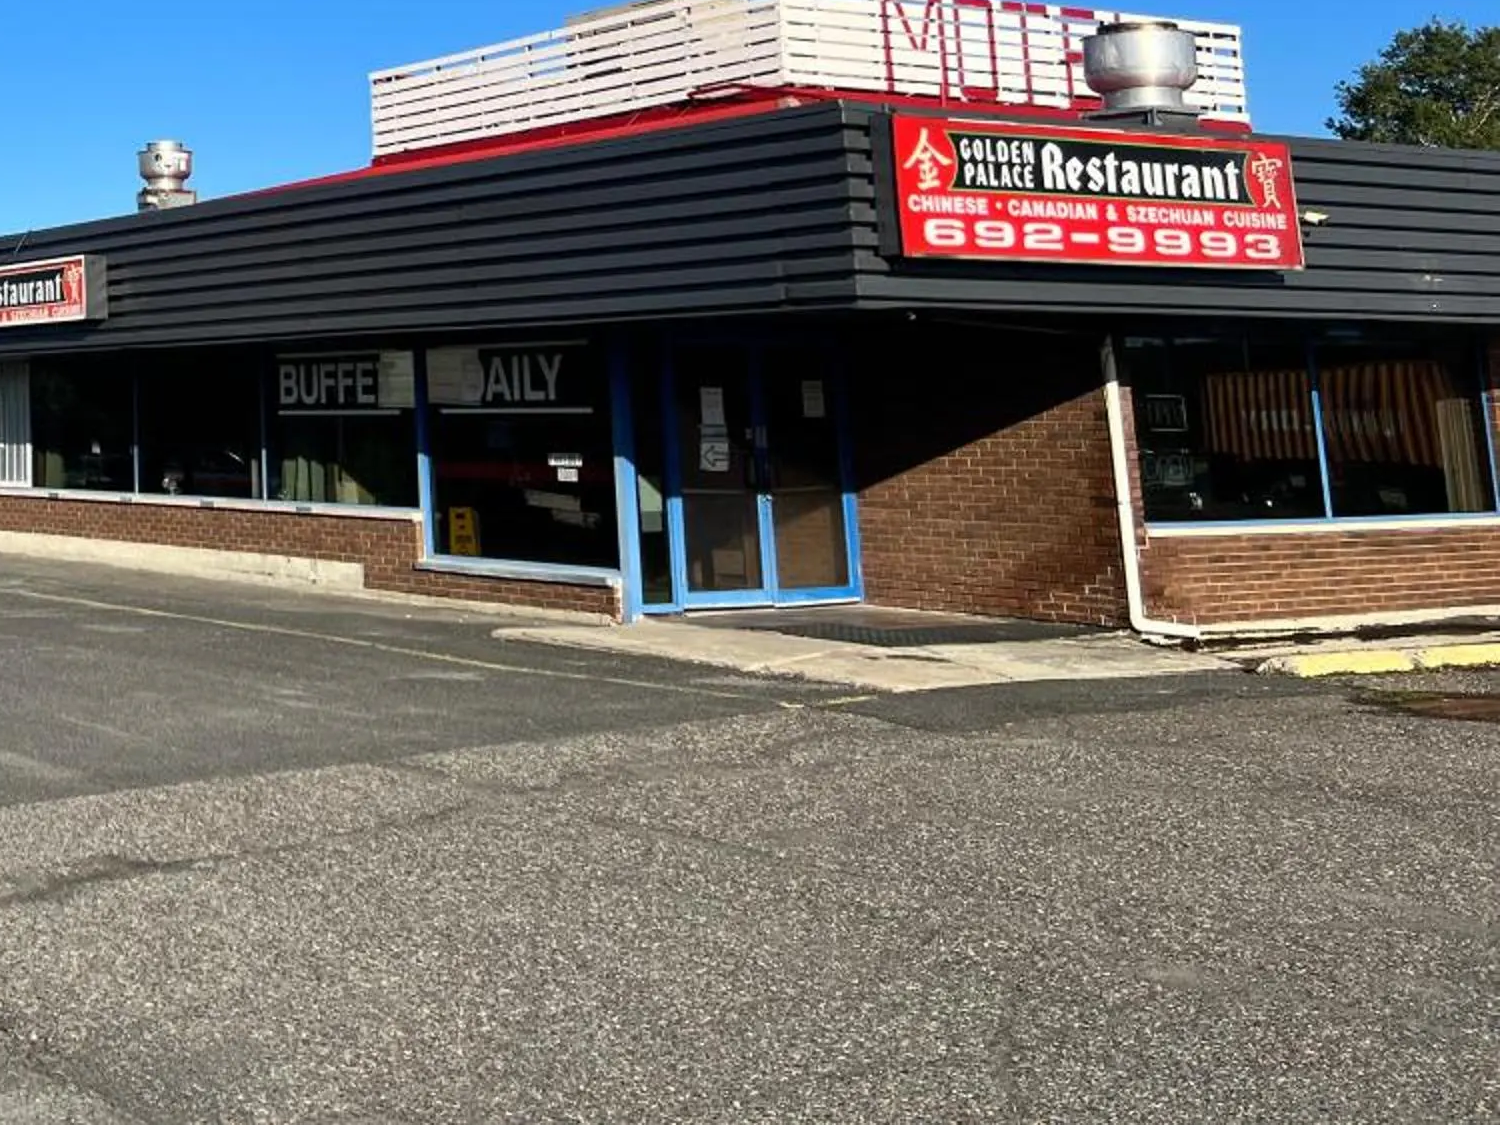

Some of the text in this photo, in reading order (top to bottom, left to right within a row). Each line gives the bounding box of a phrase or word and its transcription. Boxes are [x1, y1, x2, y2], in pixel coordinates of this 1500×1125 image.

[903, 127, 953, 191] 金
[959, 137, 1035, 164] GOLDEN
[1041, 142, 1239, 201] Restaurant
[964, 162, 1035, 189] PALACE
[907, 194, 1287, 230] CHINESE CANADIAN & SZECHUAN CUISINE
[923, 218, 1281, 260] 692-9993
[278, 361, 381, 405] BUFFE
[474, 353, 563, 403] AILY
